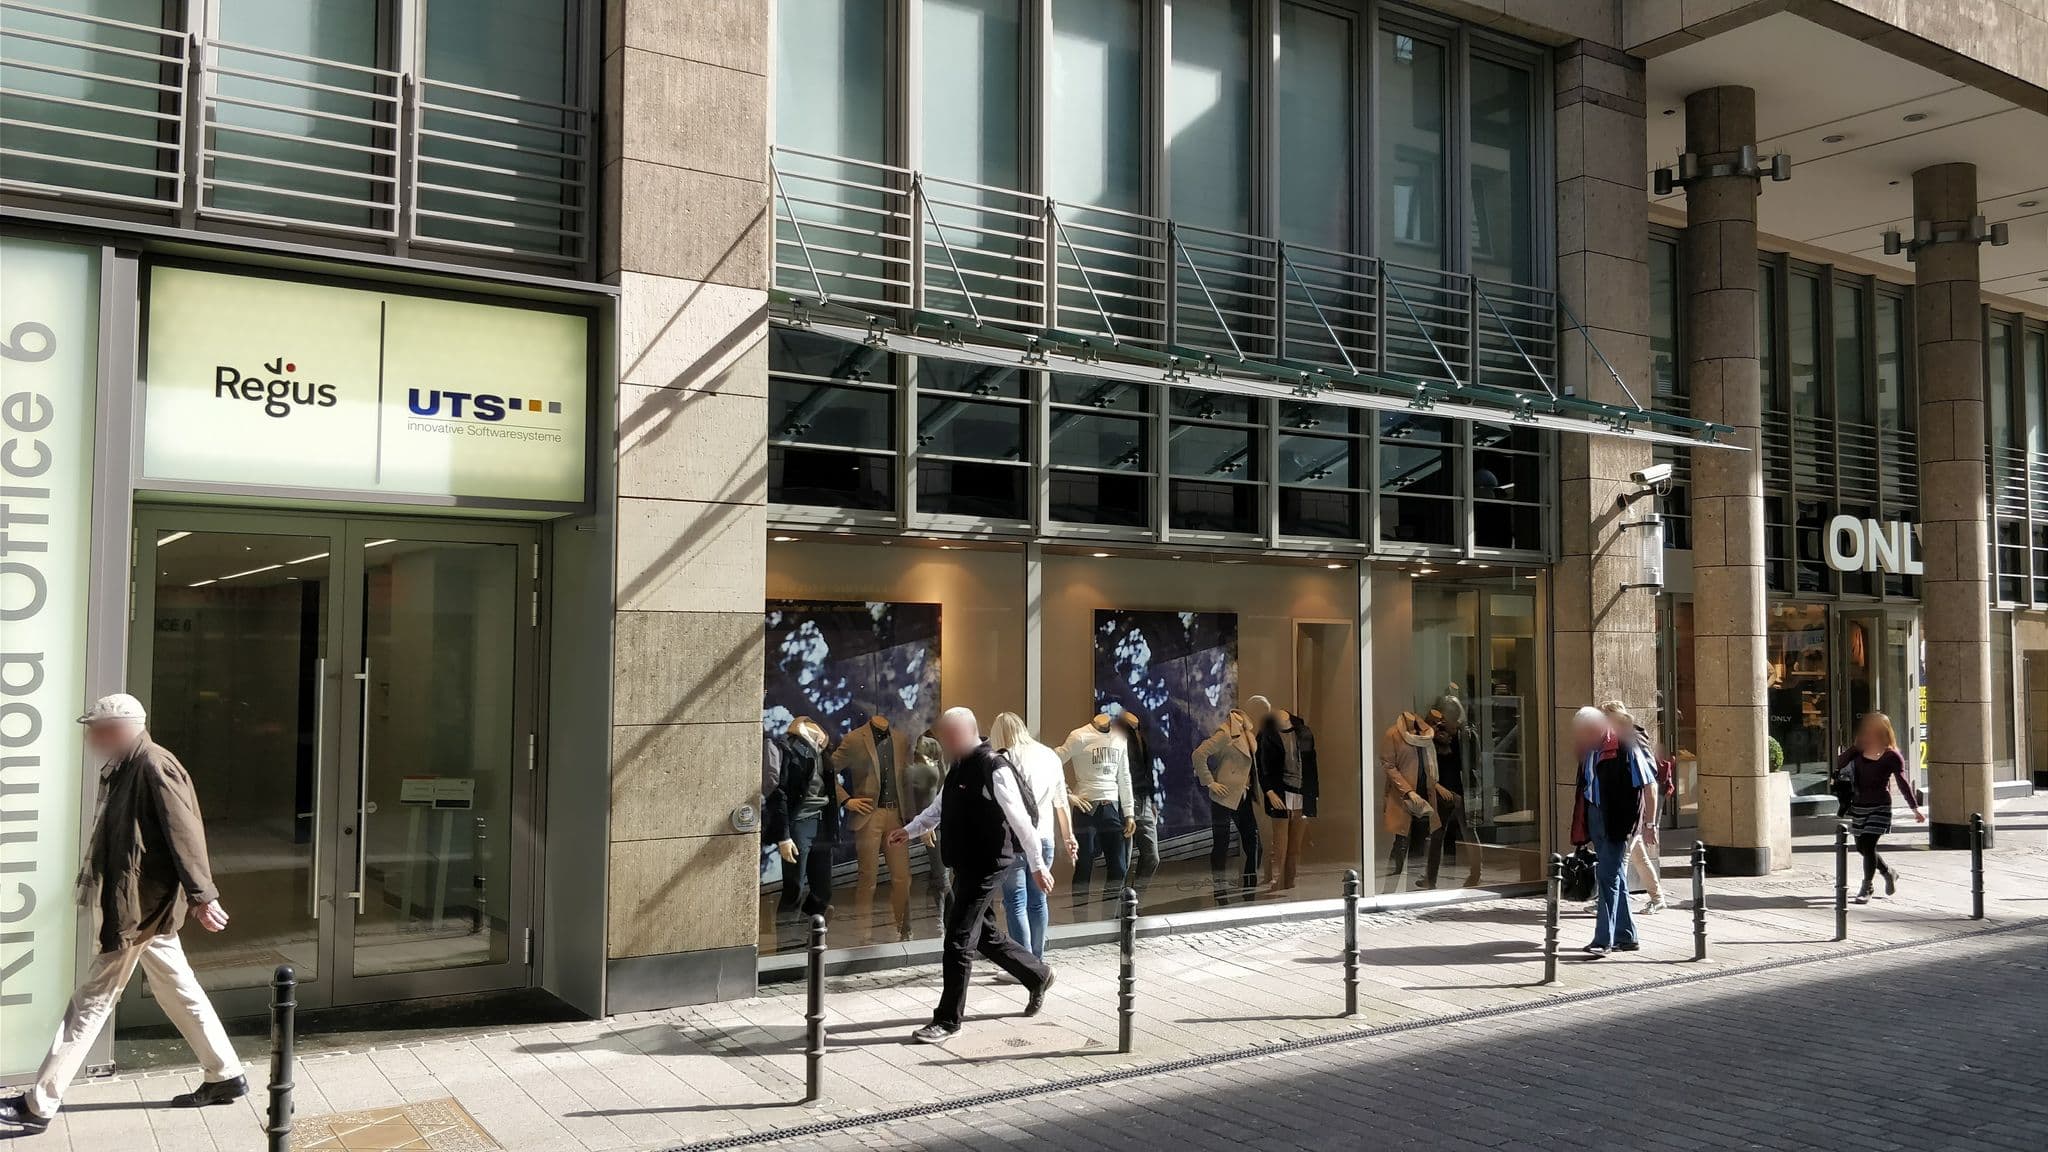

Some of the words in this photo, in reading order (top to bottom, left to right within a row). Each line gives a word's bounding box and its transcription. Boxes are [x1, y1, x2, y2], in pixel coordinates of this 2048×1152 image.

[0, 321, 57, 362] 6
[215, 366, 337, 418] Regus
[408, 388, 506, 422] UTS
[407, 420, 464, 435] innovative
[467, 425, 562, 443] Softwaresysteme
[0, 391, 54, 621] Office
[1823, 514, 1924, 576] ONL
[1770, 715, 1792, 723] ONLY
